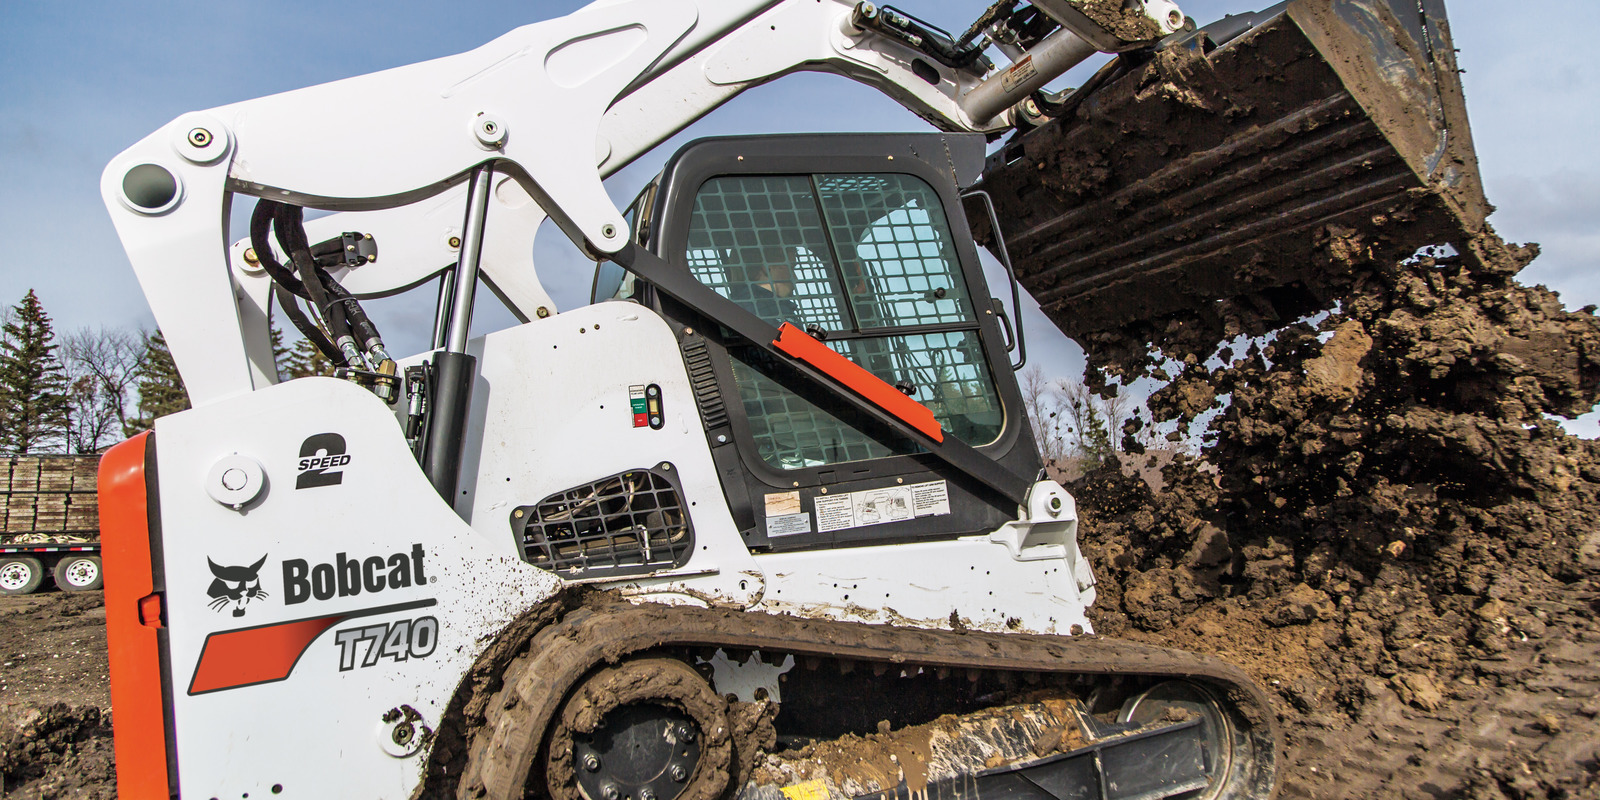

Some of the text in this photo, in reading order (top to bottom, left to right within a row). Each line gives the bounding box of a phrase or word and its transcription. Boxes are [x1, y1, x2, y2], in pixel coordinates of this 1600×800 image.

[295, 432, 347, 490] 2
[297, 454, 351, 471] SPEED
[282, 543, 427, 605] Bobcat
[335, 616, 439, 672] T740
